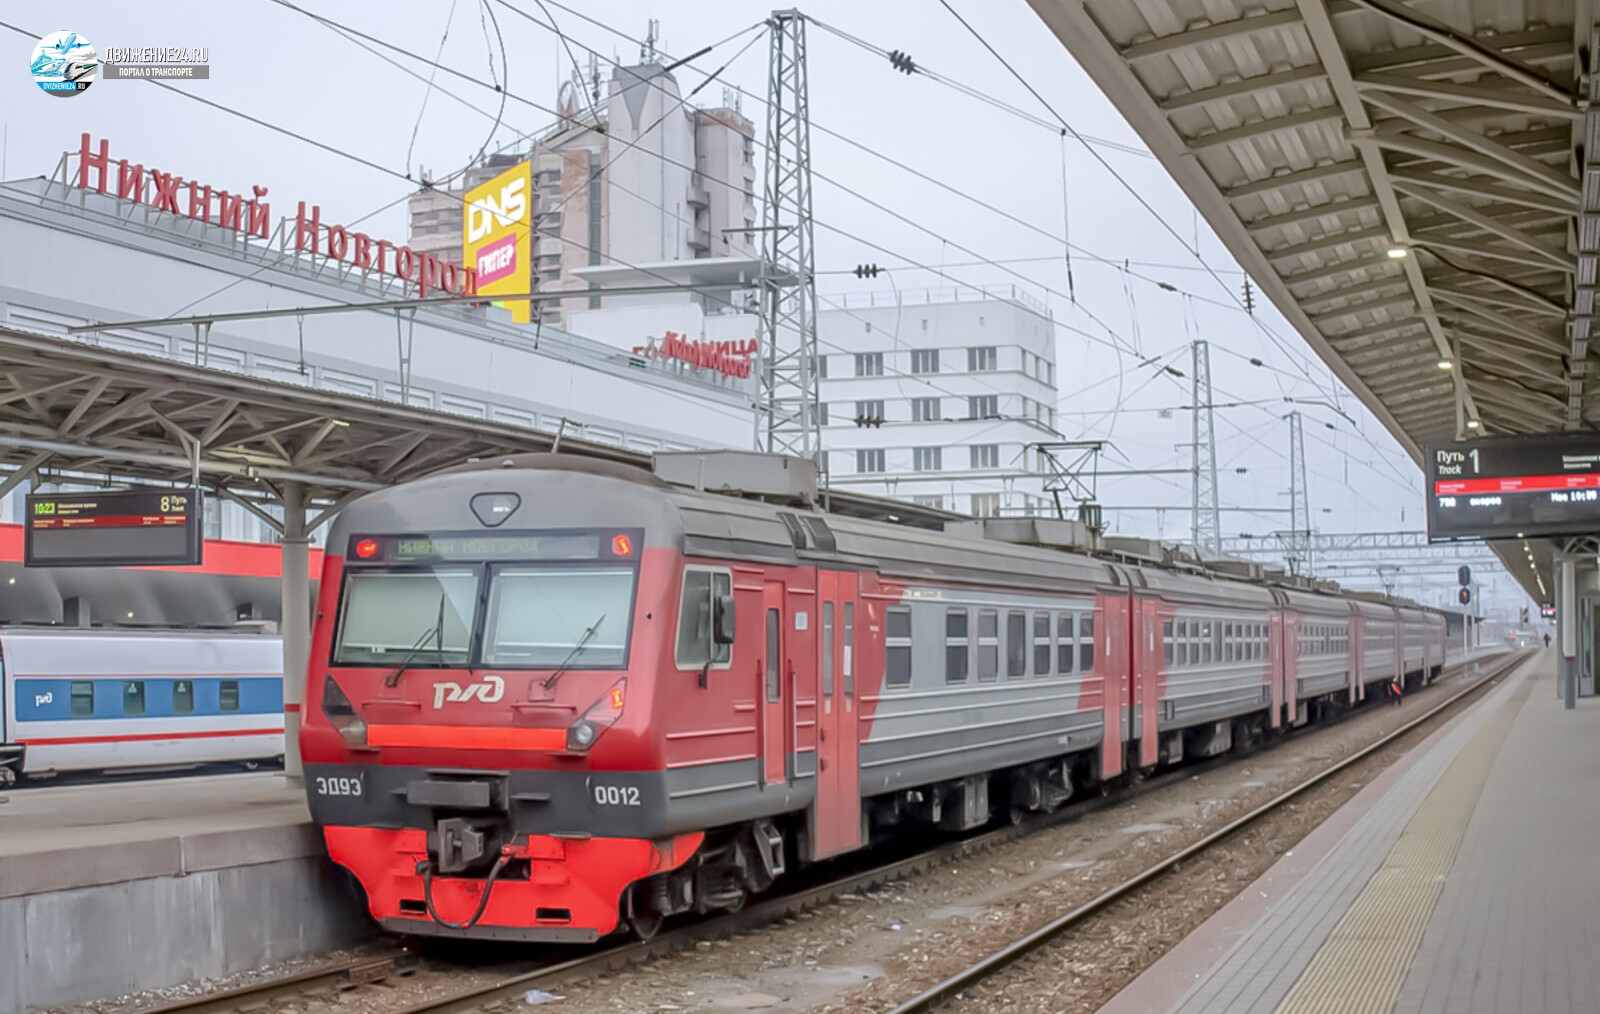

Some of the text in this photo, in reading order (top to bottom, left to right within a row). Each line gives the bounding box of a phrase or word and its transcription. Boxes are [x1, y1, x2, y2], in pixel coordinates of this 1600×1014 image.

[468, 176, 526, 245] DNS
[1437, 449, 1480, 474] Путь 1
[160, 496, 170, 512] 8
[594, 785, 641, 806] 0012
